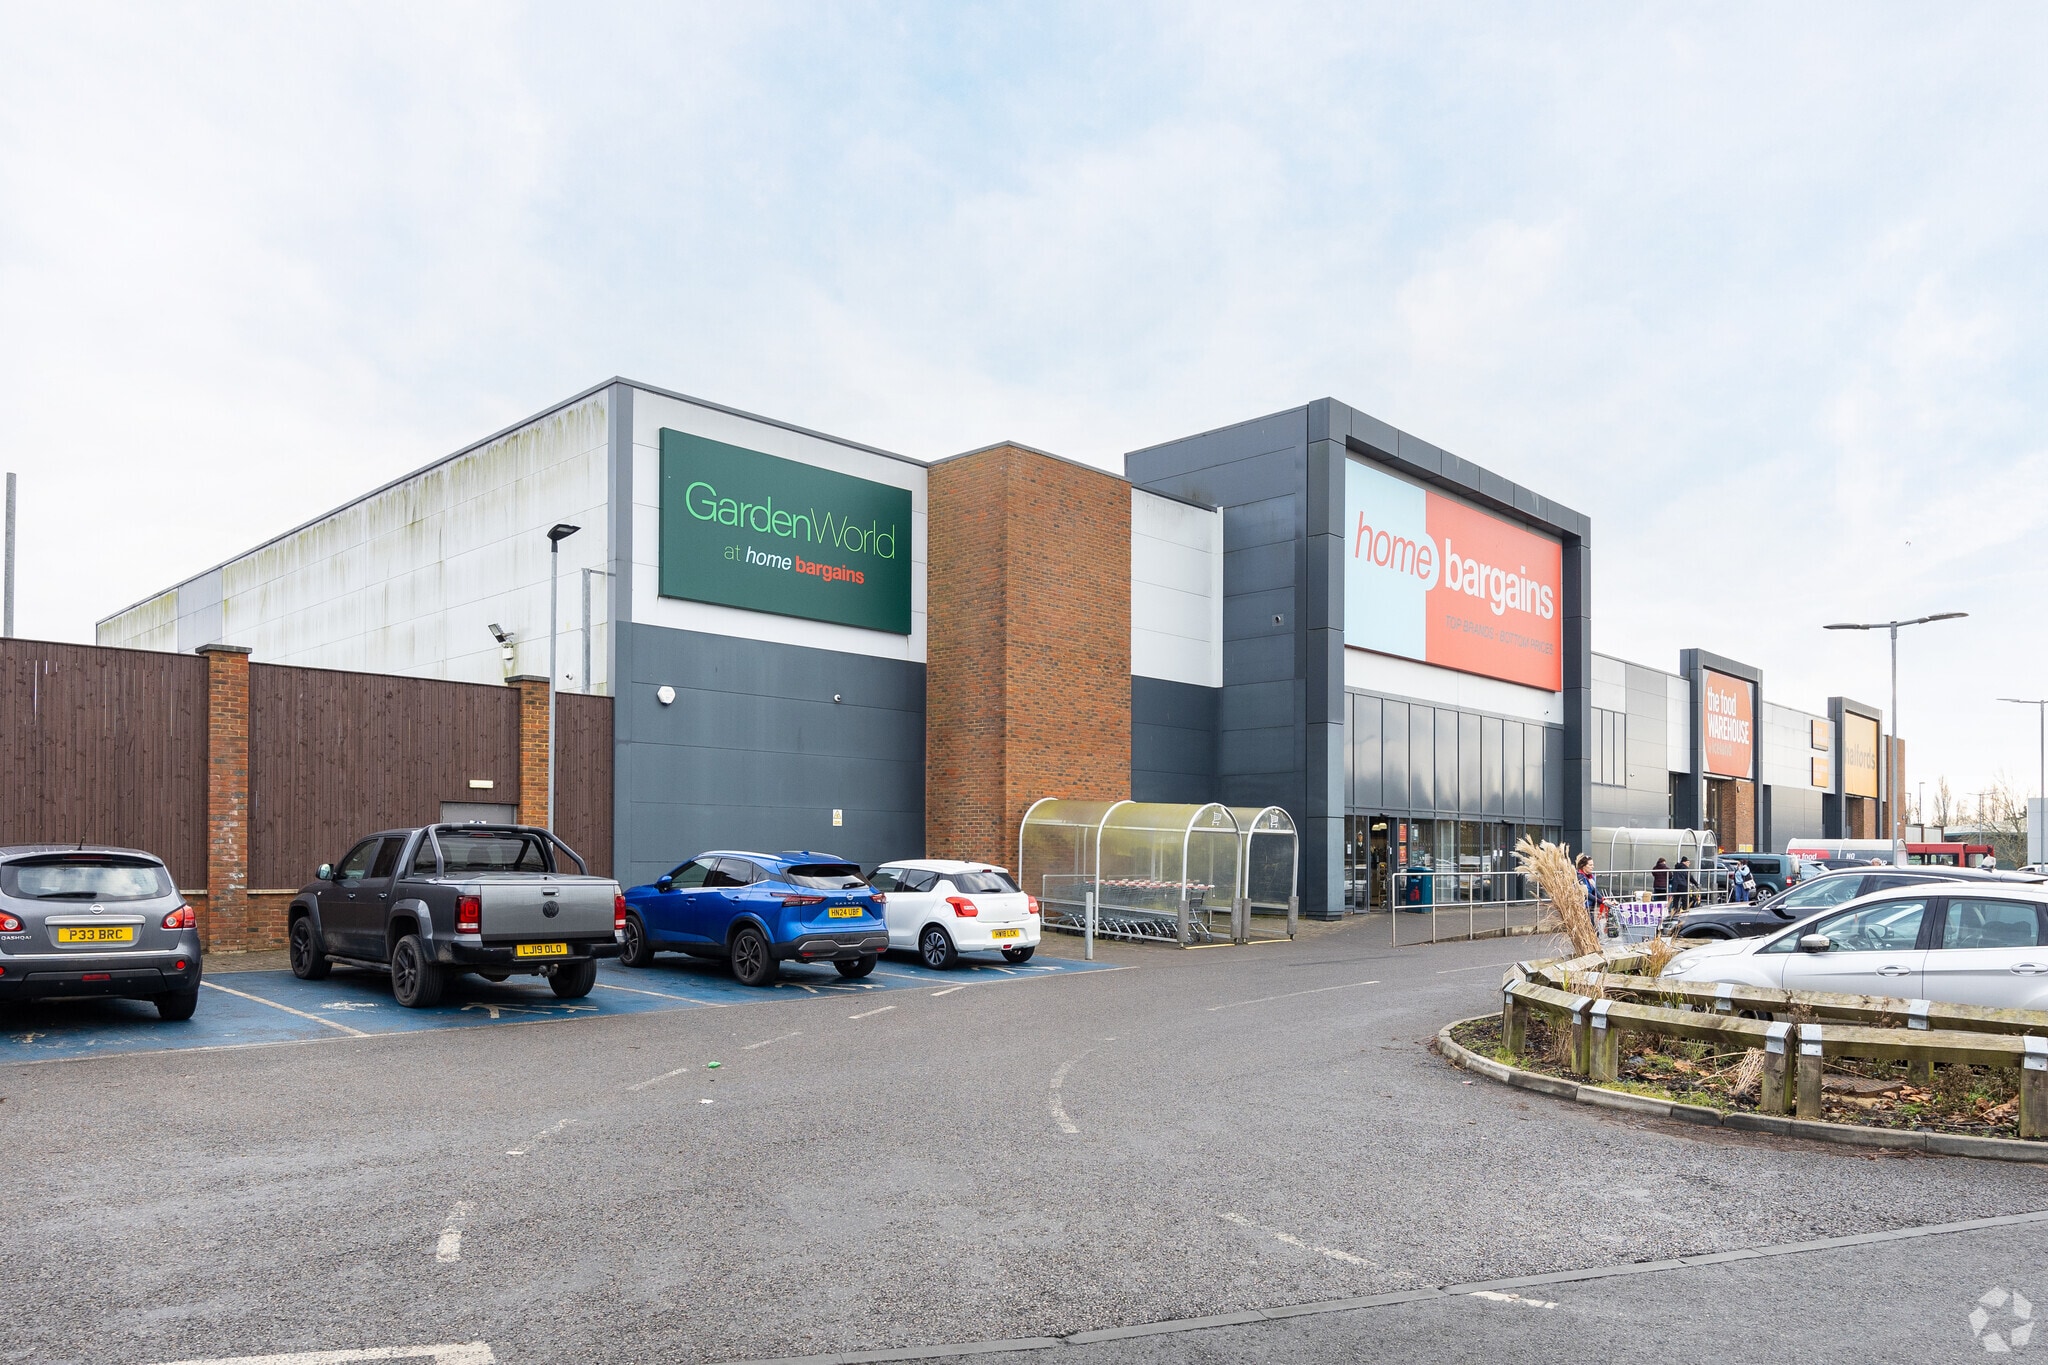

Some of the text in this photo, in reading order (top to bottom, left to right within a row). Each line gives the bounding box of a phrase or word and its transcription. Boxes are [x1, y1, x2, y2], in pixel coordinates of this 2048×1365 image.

[685, 481, 895, 559] GardenWorld
[724, 545, 865, 585] at home bargains
[1355, 511, 1554, 620] home bargains
[1445, 615, 1462, 630] TOP
[1463, 619, 1494, 640] BRANDS
[1499, 630, 1529, 649] BOTTOM
[1530, 638, 1553, 655] PRICES
[1707, 686, 1737, 716] the food
[1707, 713, 1750, 745] WAREHOUSE
[69, 929, 123, 940] P33 BRC
[523, 945, 542, 955] LJ19
